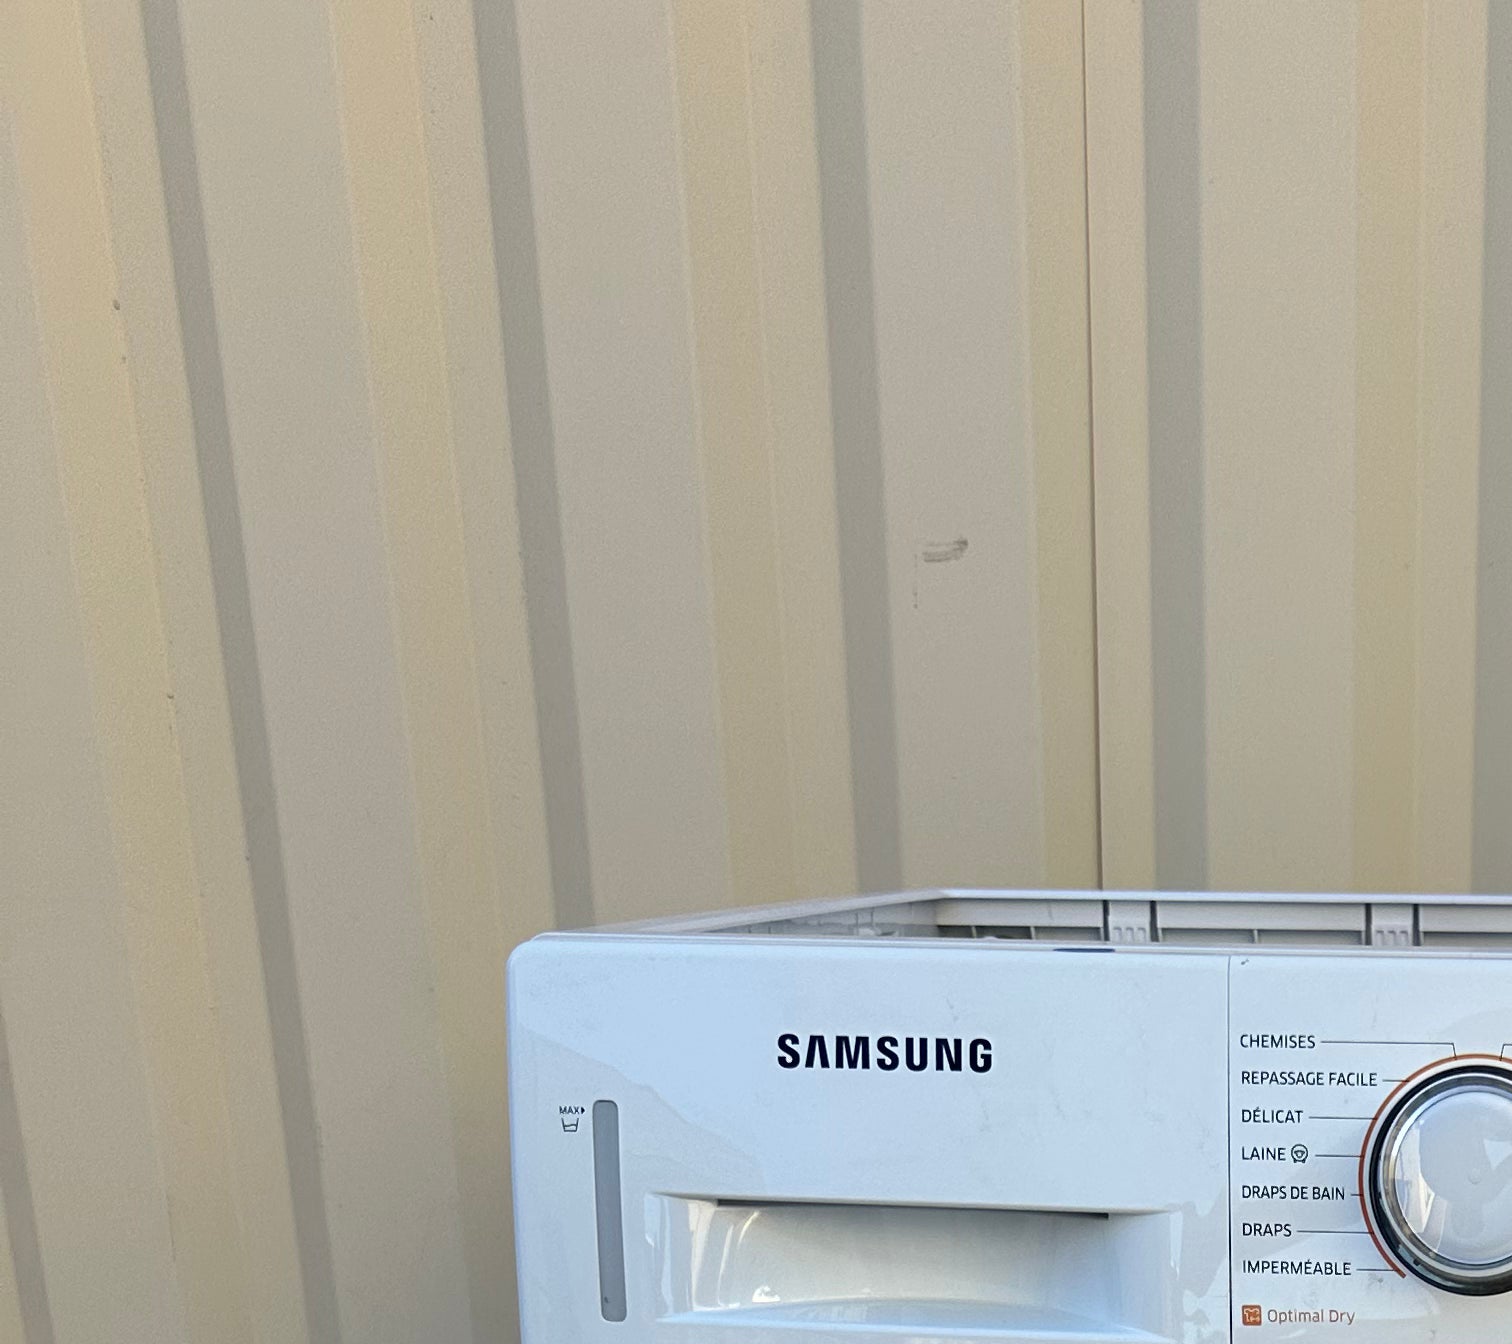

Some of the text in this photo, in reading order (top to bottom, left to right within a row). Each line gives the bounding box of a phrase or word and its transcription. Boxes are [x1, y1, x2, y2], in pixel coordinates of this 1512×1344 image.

[1240, 1034, 1315, 1048] CHEMISES
[777, 1034, 992, 1073] SAMSUNG
[1242, 1071, 1378, 1086] REPASSAGE FACILE
[559, 1106, 579, 1114] MAX
[1241, 1106, 1303, 1124] DÉLICAT
[1241, 1146, 1286, 1161] LAINE
[1242, 1185, 1345, 1200] DRAPS DE BAIN
[1242, 1223, 1292, 1237] DRAPS
[1243, 1259, 1351, 1276] IMPERMÉABLE
[1267, 1309, 1355, 1325] Optimal Dry
